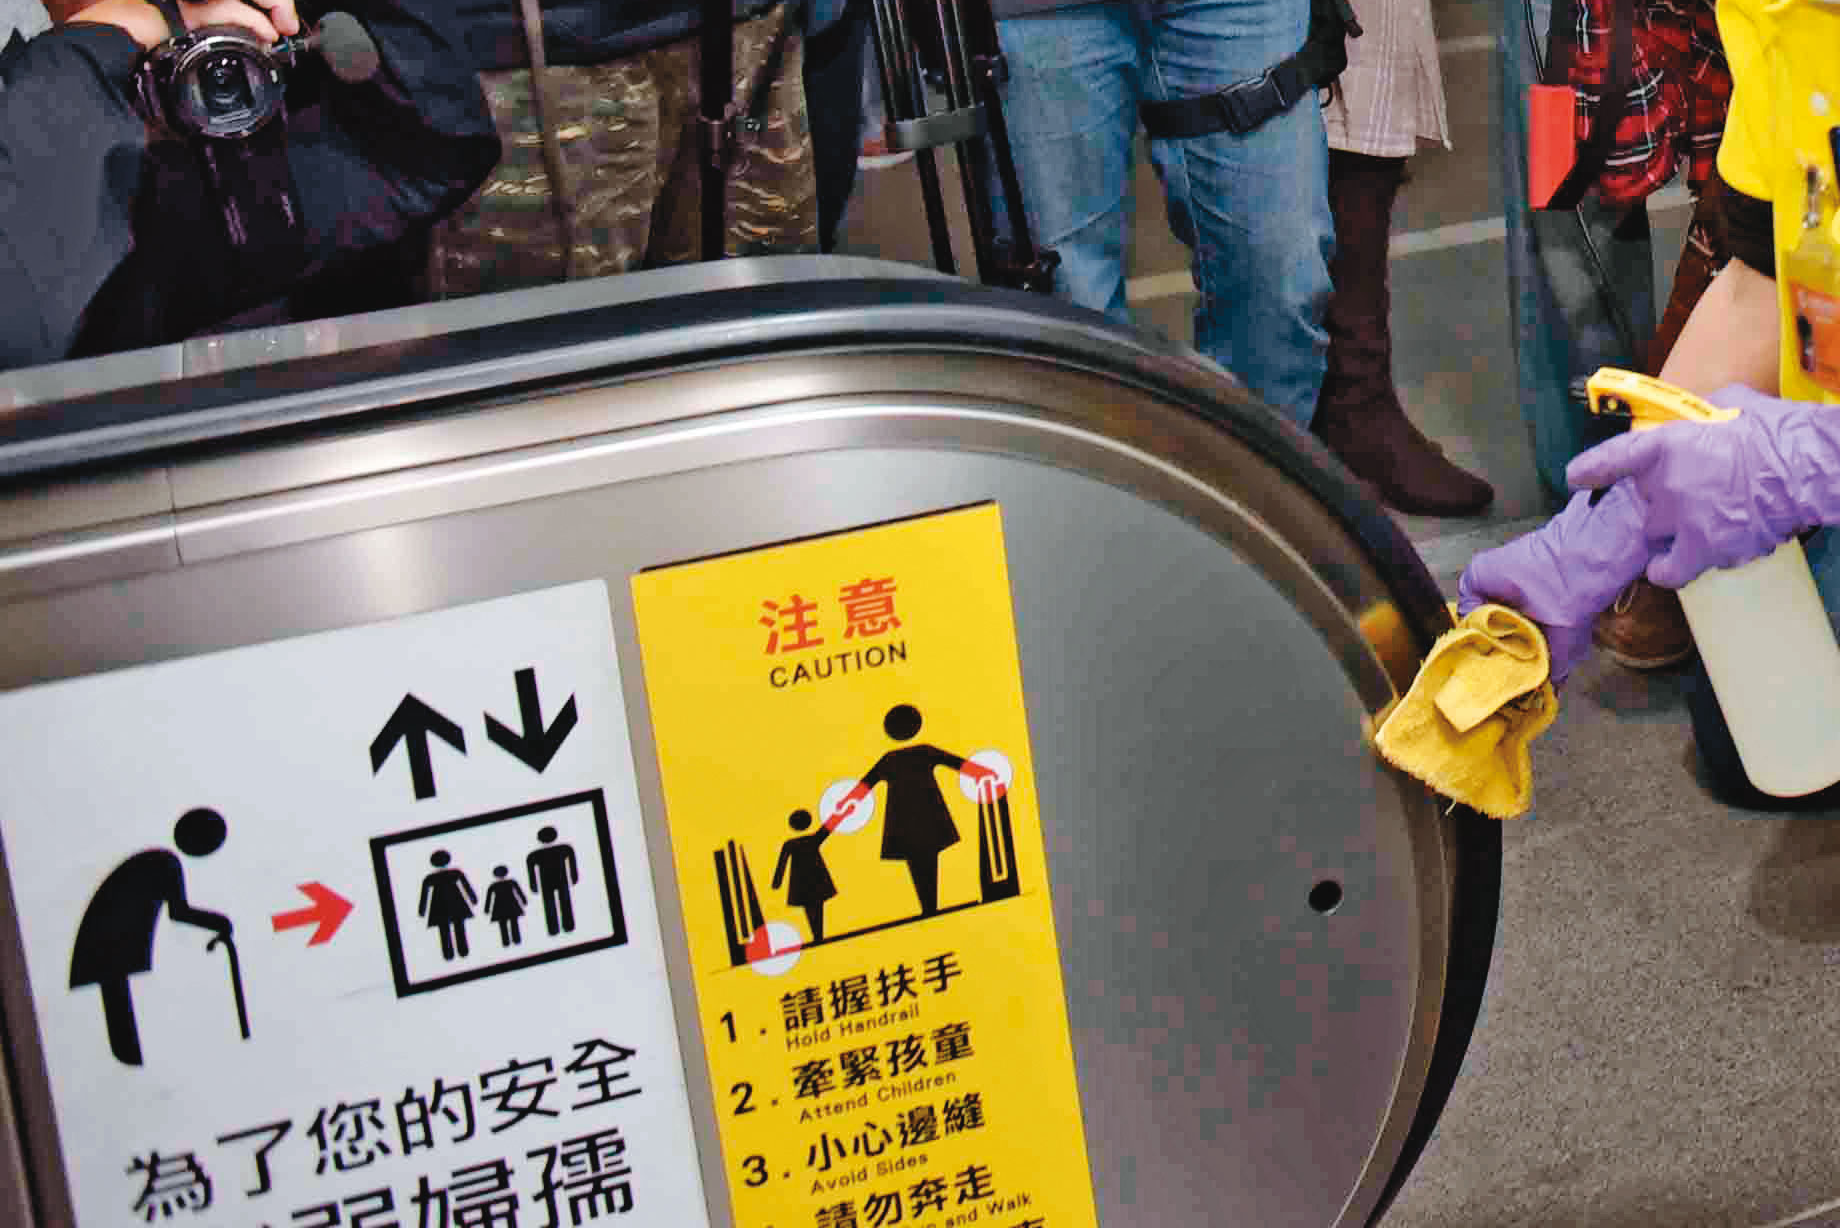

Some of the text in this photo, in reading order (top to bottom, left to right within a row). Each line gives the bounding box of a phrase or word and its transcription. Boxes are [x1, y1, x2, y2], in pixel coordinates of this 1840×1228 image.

[759, 577, 902, 655] 注意
[770, 641, 907, 688] CAUTION
[780, 952, 962, 1031] 請握扶手
[786, 1004, 920, 1051] Hold Handrail
[792, 1021, 975, 1100] 牽緊孩童
[126, 1038, 642, 1222] 為了您的安全
[800, 1072, 957, 1124] Attend Children
[807, 1091, 985, 1172] 小心邊縫
[811, 1153, 928, 1195] Avoid Sides
[986, 1192, 1033, 1216] Walk
